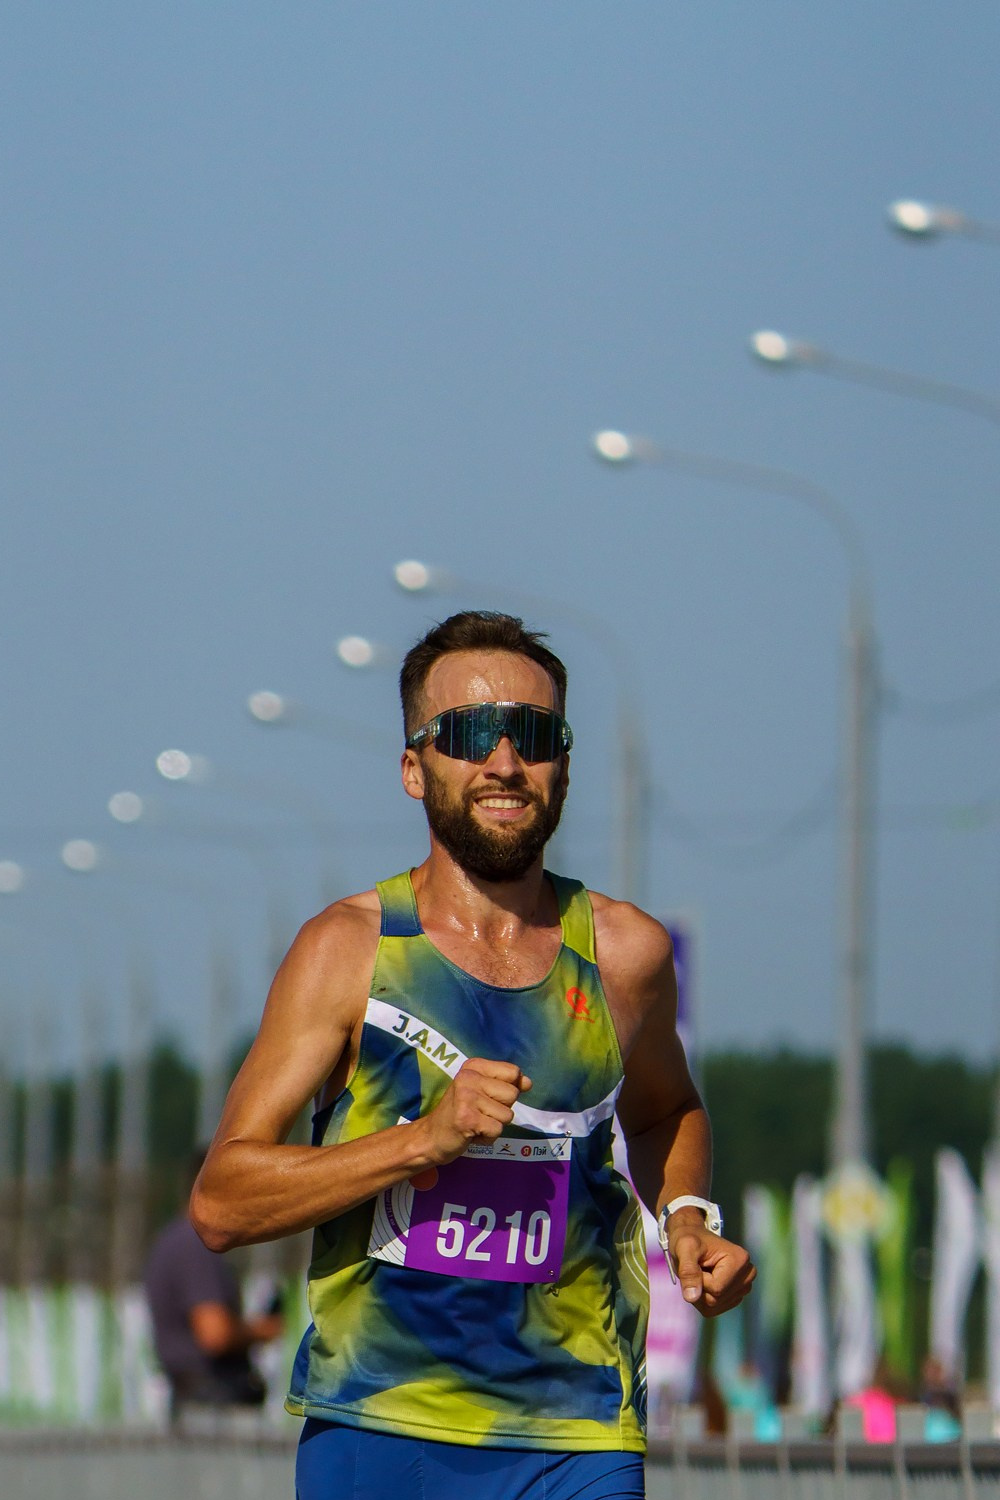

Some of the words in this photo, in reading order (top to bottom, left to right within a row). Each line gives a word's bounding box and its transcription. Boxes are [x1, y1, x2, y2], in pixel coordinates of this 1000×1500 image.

[392, 1013, 459, 1068] J.A.M
[533, 1146, 547, 1156] Пэй
[436, 1202, 552, 1266] 5210
